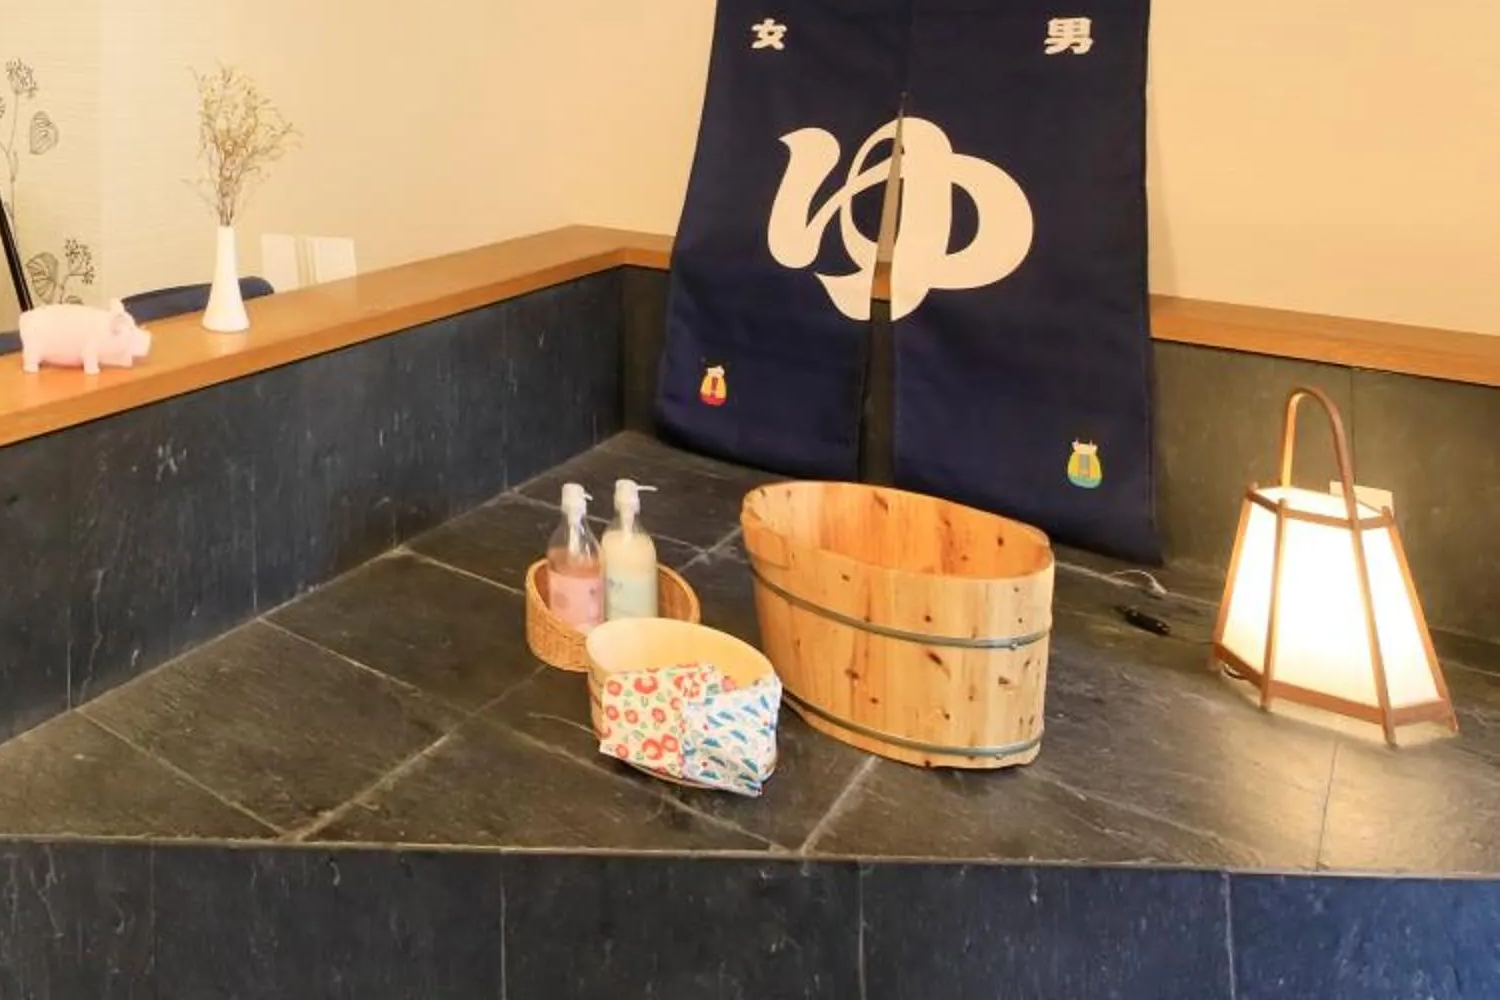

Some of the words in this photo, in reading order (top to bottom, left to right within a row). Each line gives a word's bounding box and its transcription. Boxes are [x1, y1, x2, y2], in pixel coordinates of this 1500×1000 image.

[751, 18, 788, 50] 女
[1043, 16, 1094, 55] 男
[767, 117, 1034, 321] ゆ
